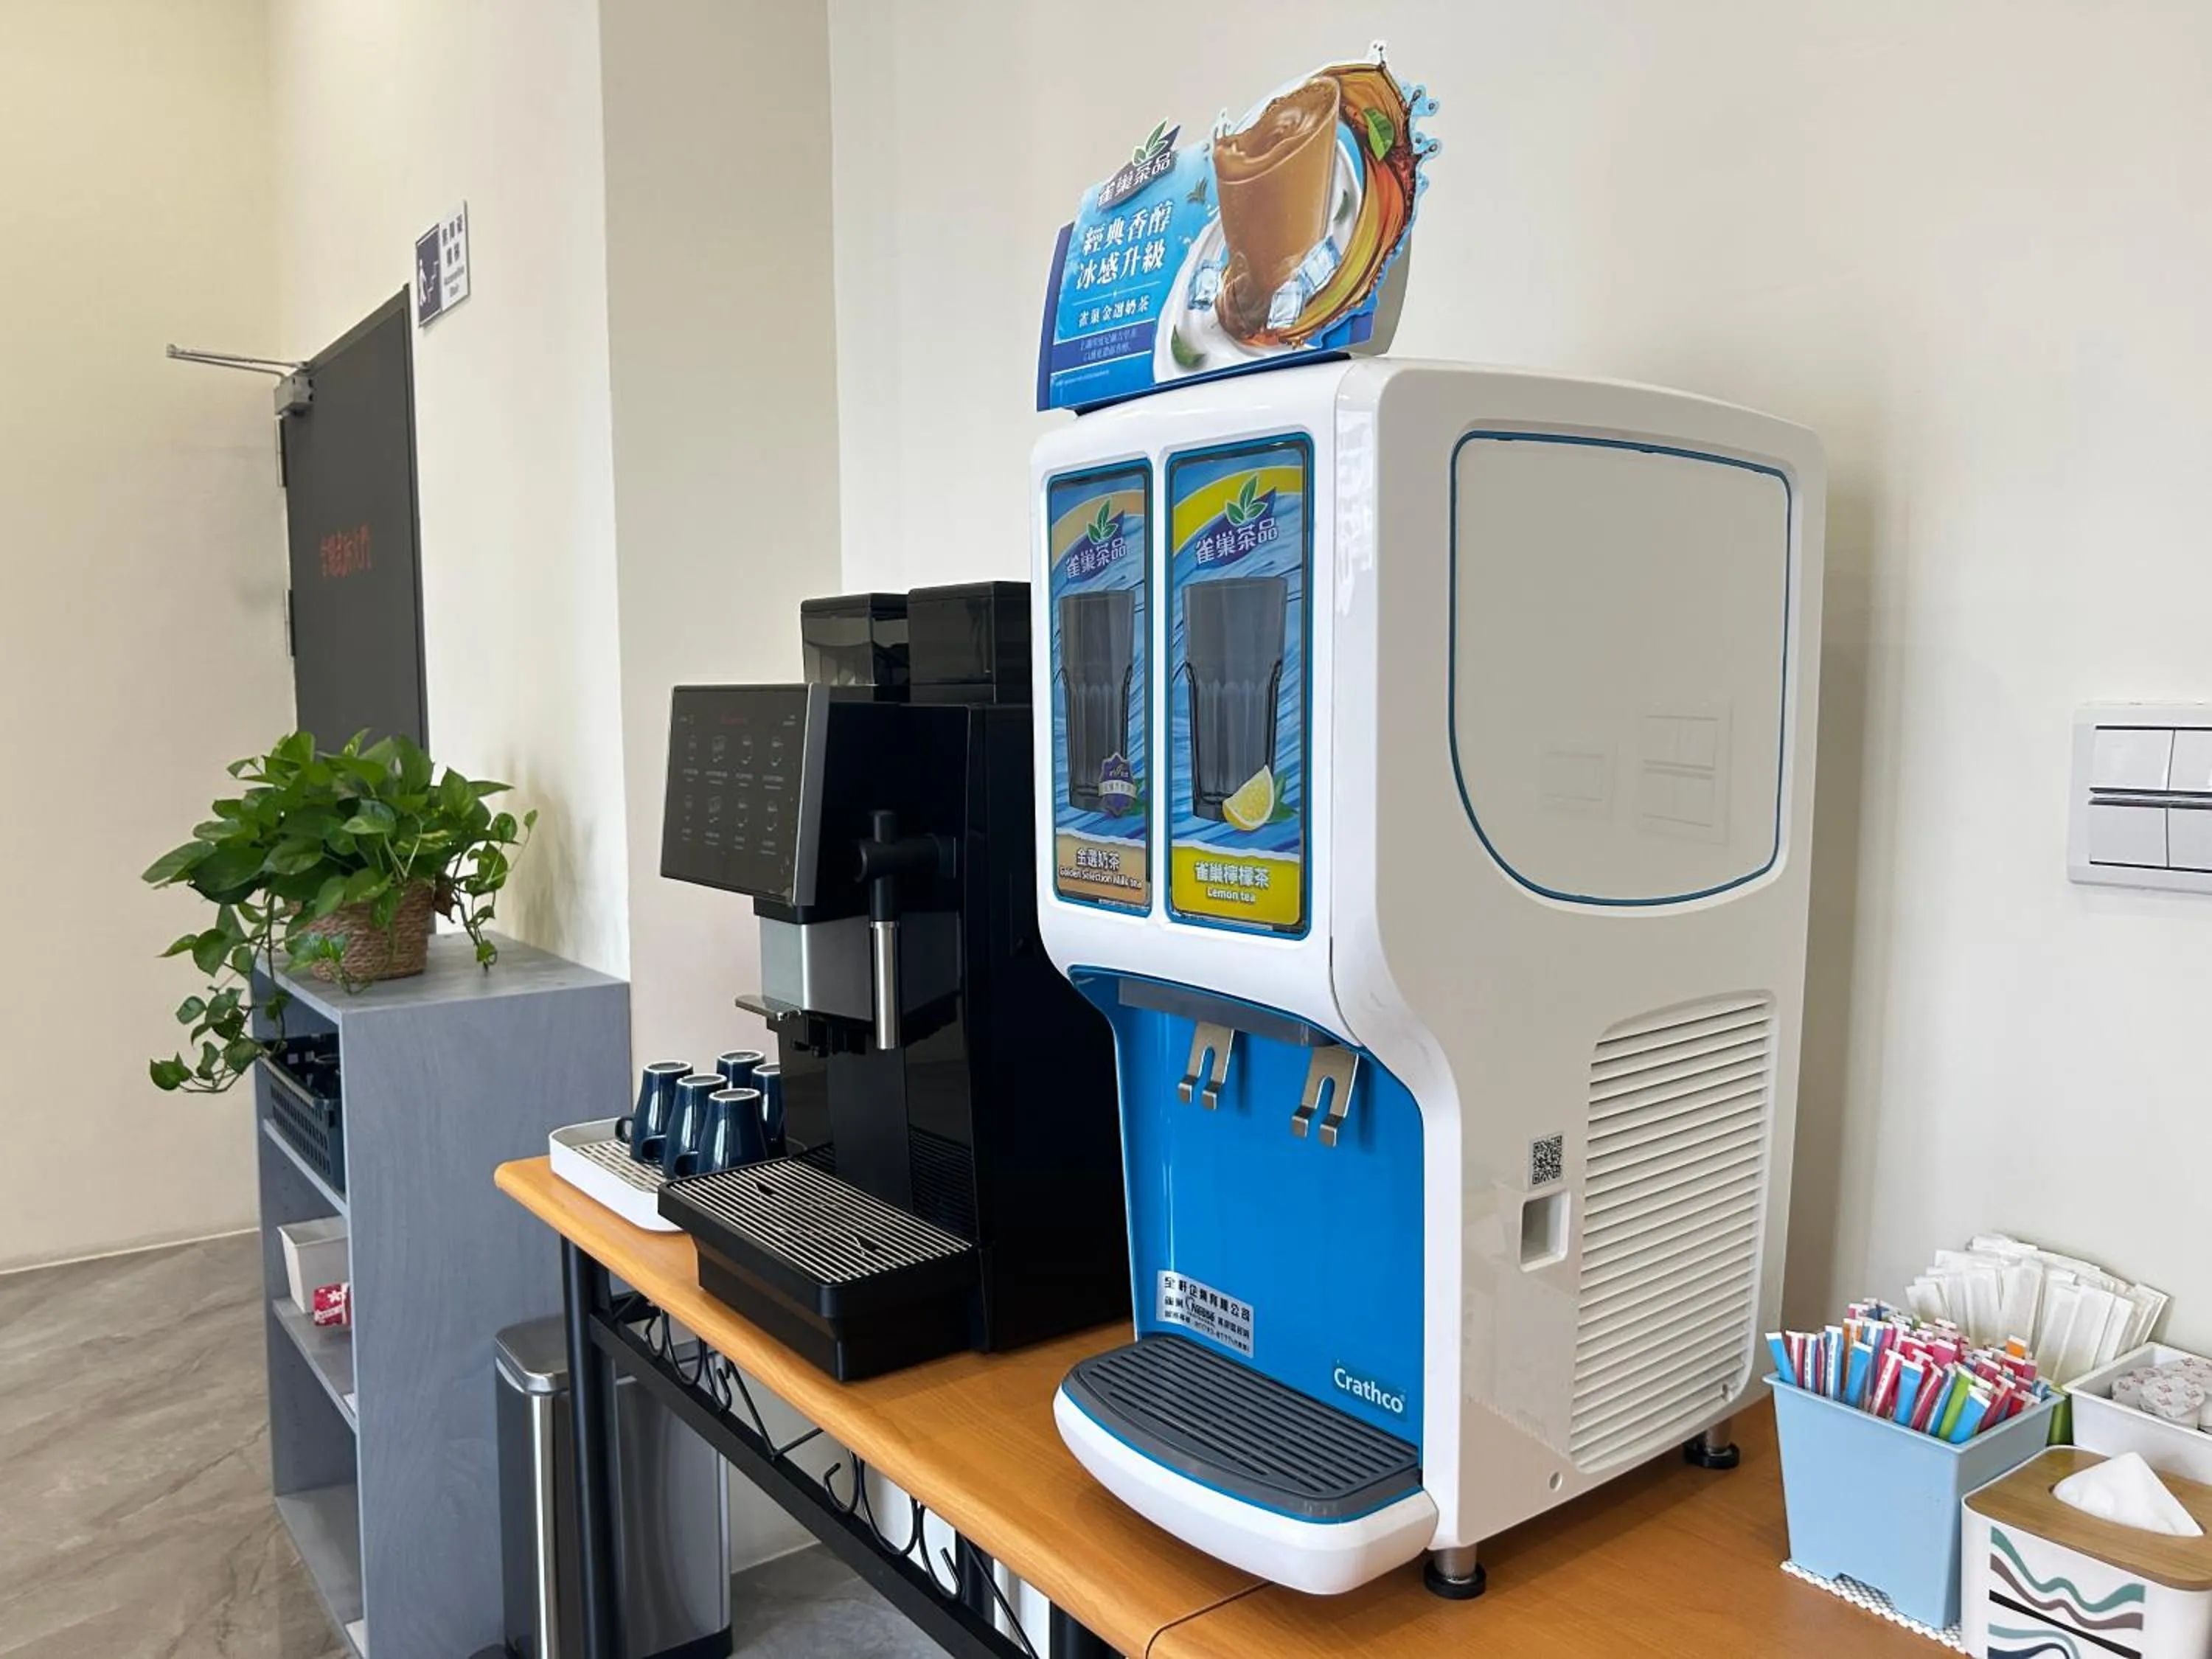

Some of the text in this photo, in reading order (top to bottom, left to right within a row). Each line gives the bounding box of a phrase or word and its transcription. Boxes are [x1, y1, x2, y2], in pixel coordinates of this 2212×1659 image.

[1097, 150, 1171, 207] 雀巢茶品
[1082, 200, 1174, 256] 經典香醇
[1075, 238, 1166, 290] 冰感升級
[1065, 536, 1127, 580] 雀巢茶品
[1194, 516, 1279, 566] 雀巢茶品
[1077, 847, 1121, 870] 金選奶茶
[1195, 860, 1270, 889] 雀巢檸檬茶
[1207, 886, 1256, 902] Lemon tea
[1333, 1367, 1404, 1413] Crathco
